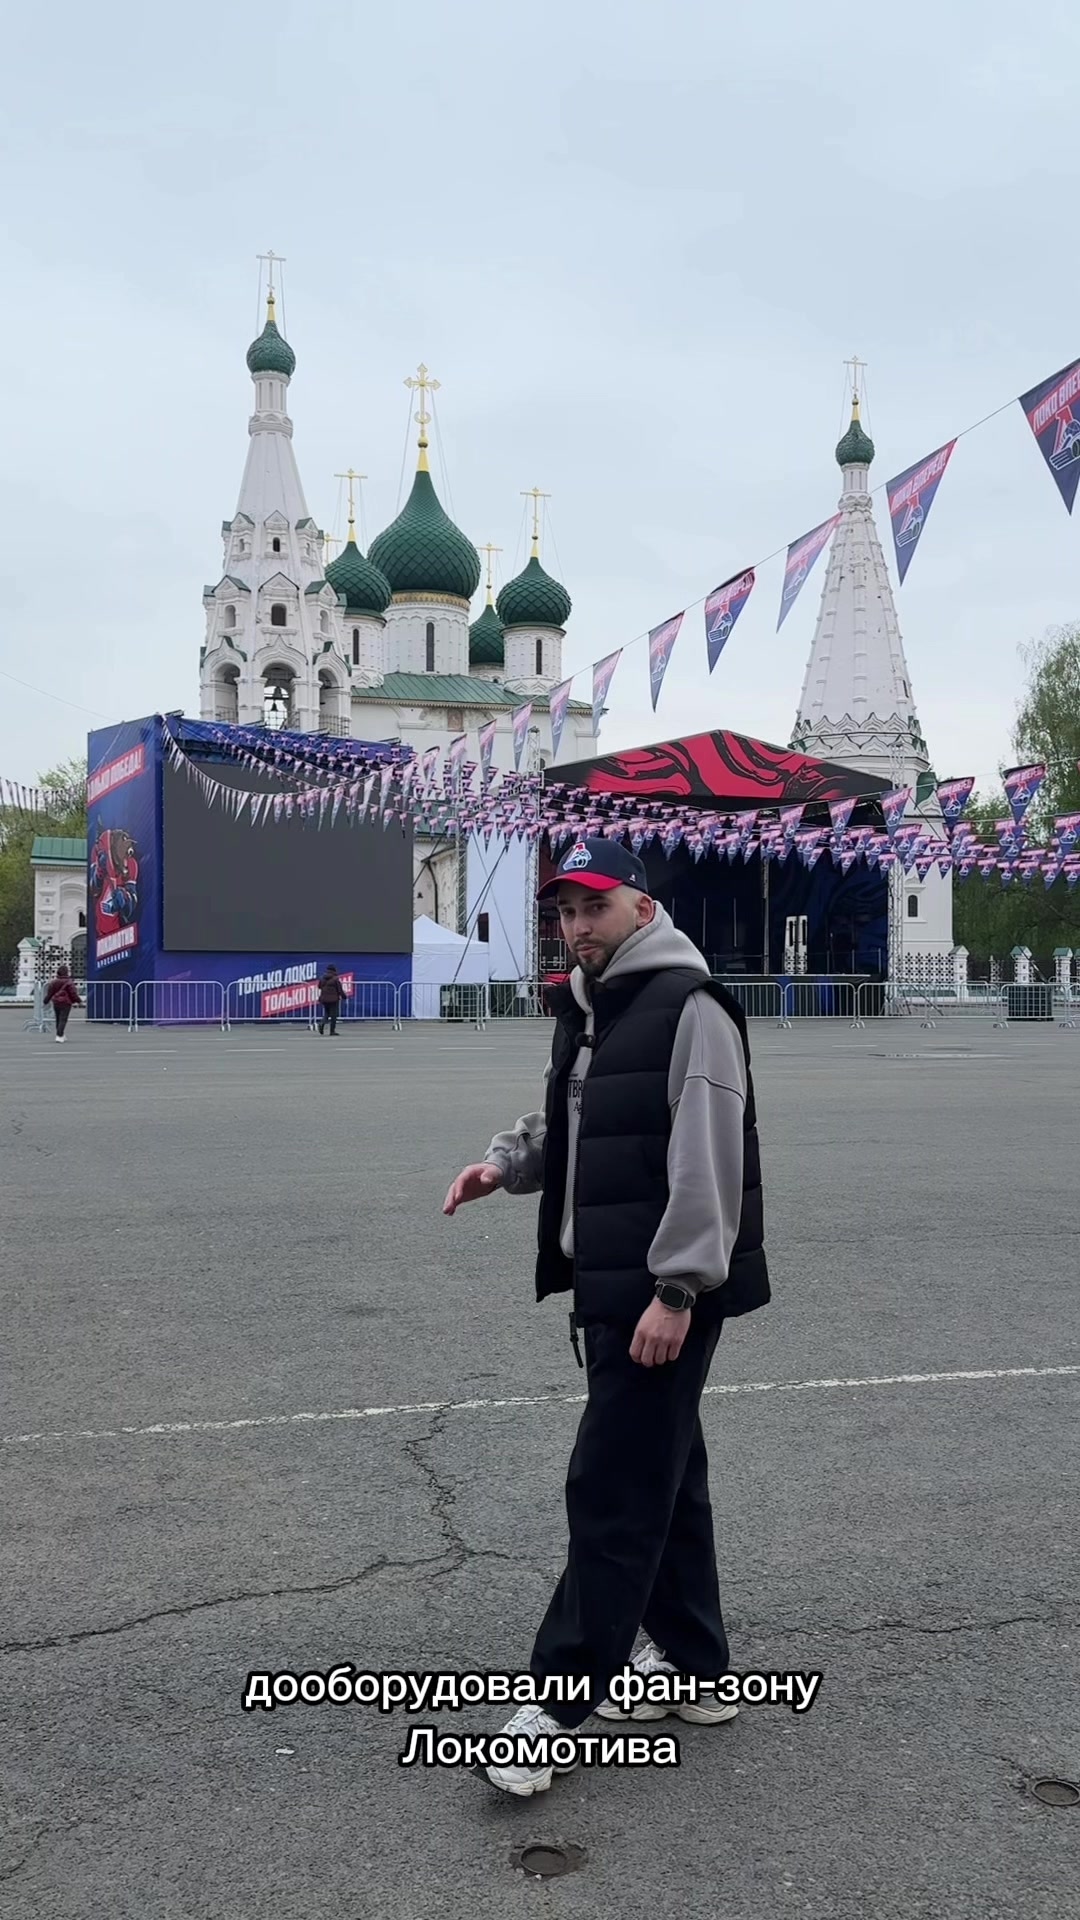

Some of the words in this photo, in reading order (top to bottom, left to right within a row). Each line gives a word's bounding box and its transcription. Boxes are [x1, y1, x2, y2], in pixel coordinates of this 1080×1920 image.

[1033, 391, 1058, 432] ЛОКО
[1059, 368, 1080, 408] ВПЕ
[237, 969, 282, 996] ТОЛЬКО
[284, 961, 317, 987] ЛОКО!
[264, 986, 307, 1014] ТОЛЬКО
